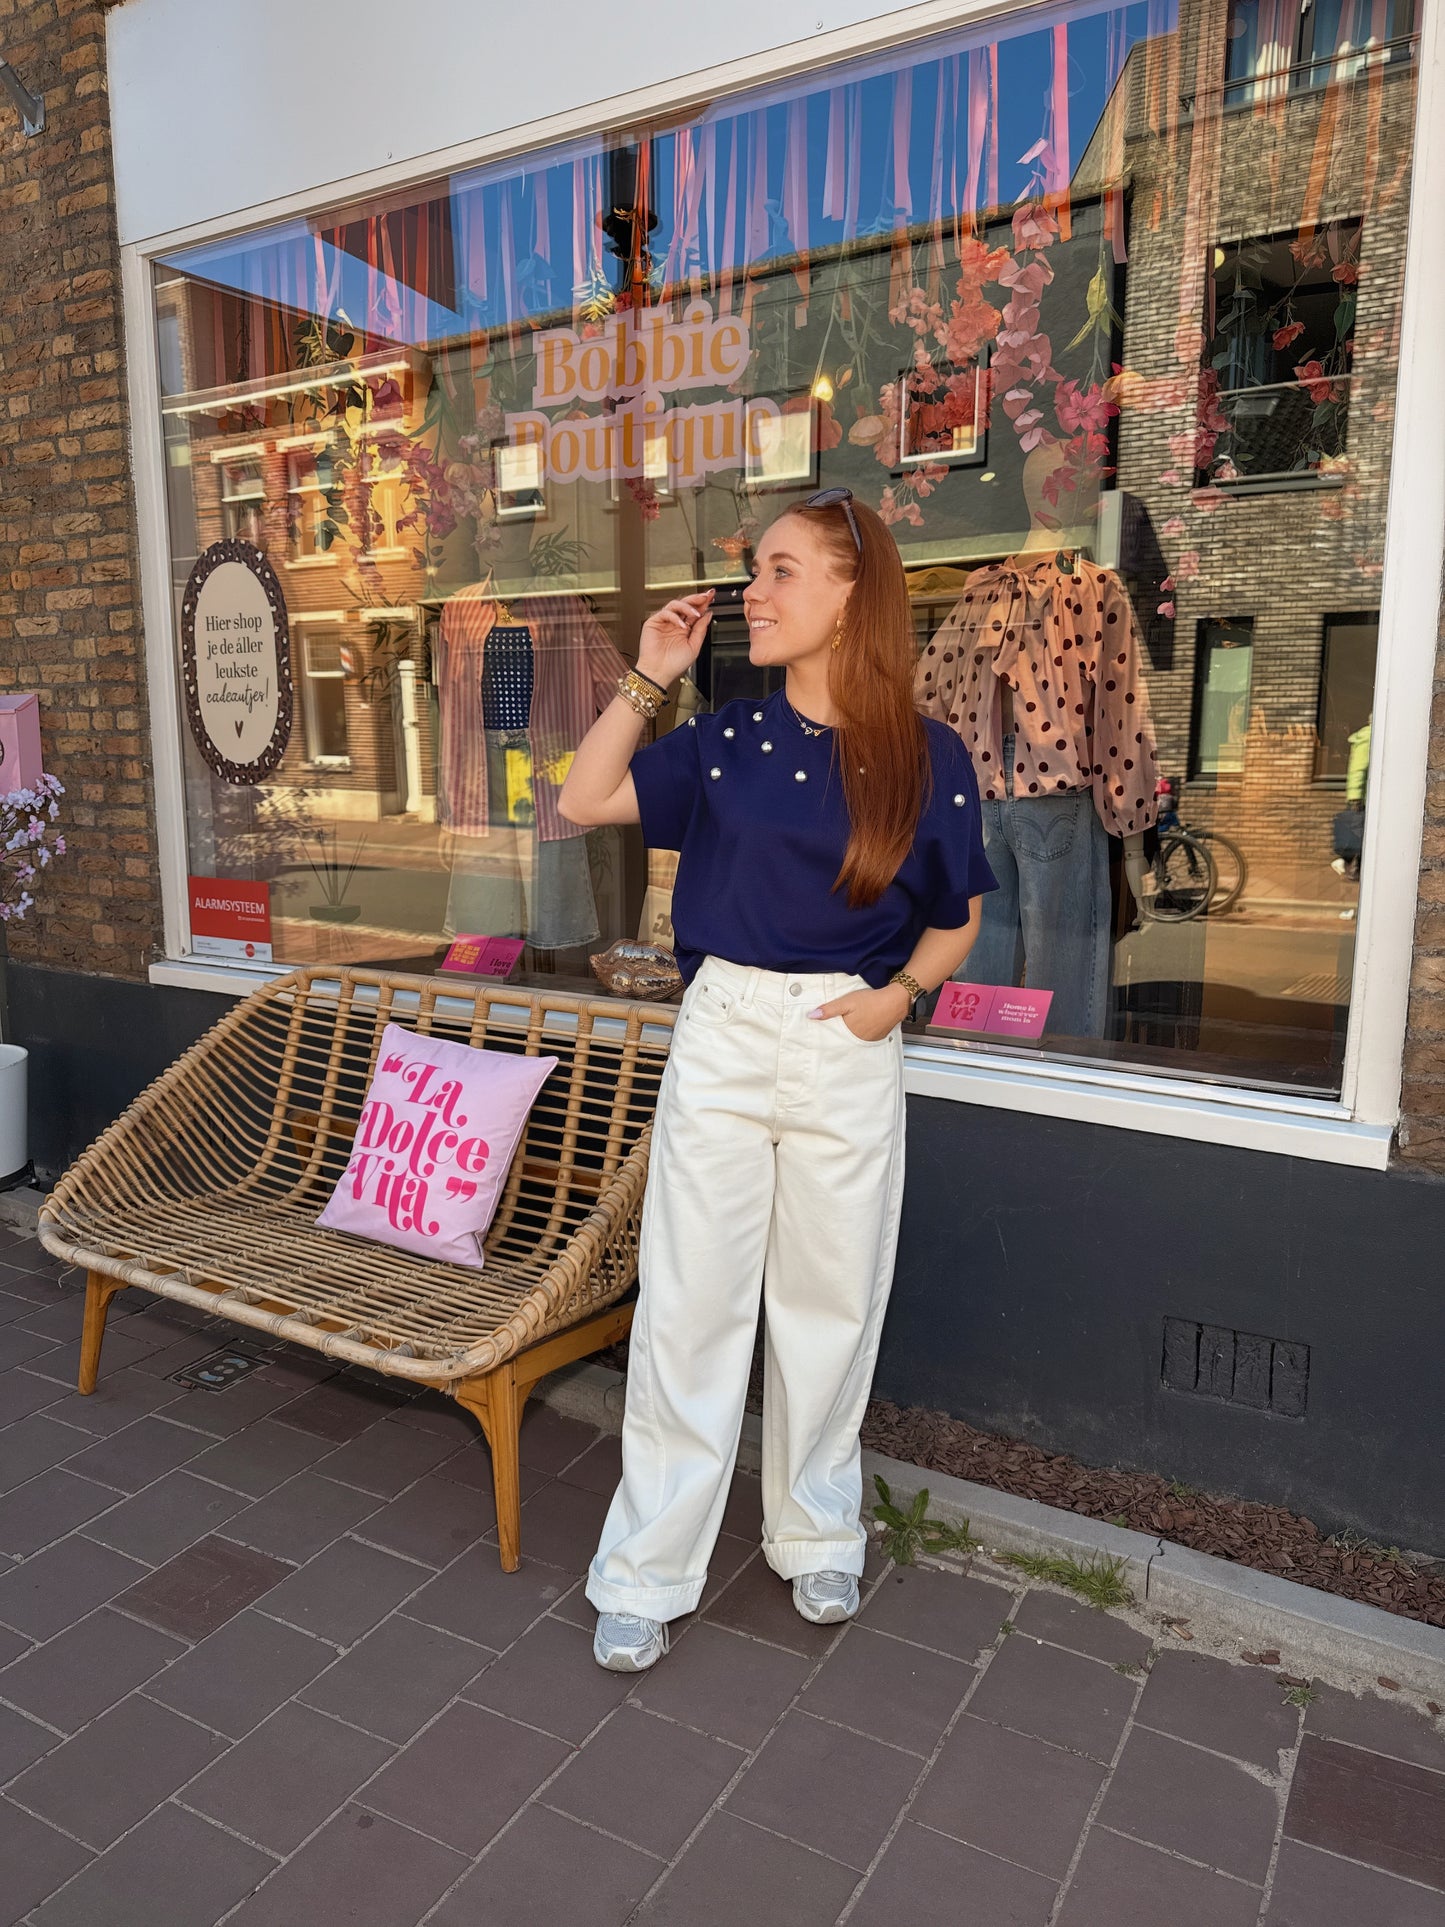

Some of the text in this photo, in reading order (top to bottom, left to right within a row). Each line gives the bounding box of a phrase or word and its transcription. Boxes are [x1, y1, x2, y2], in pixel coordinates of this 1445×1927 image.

[540, 310, 741, 398] Bobbie
[512, 400, 773, 478] Boutique
[205, 613, 262, 633] Hier shop
[207, 637, 263, 660] je de áller
[215, 662, 258, 679] leukste
[206, 677, 269, 714] cadeautjes!
[195, 897, 265, 914] ALARMSYSTEEM
[495, 959, 511, 968] love
[359, 1100, 490, 1178] Dolce
